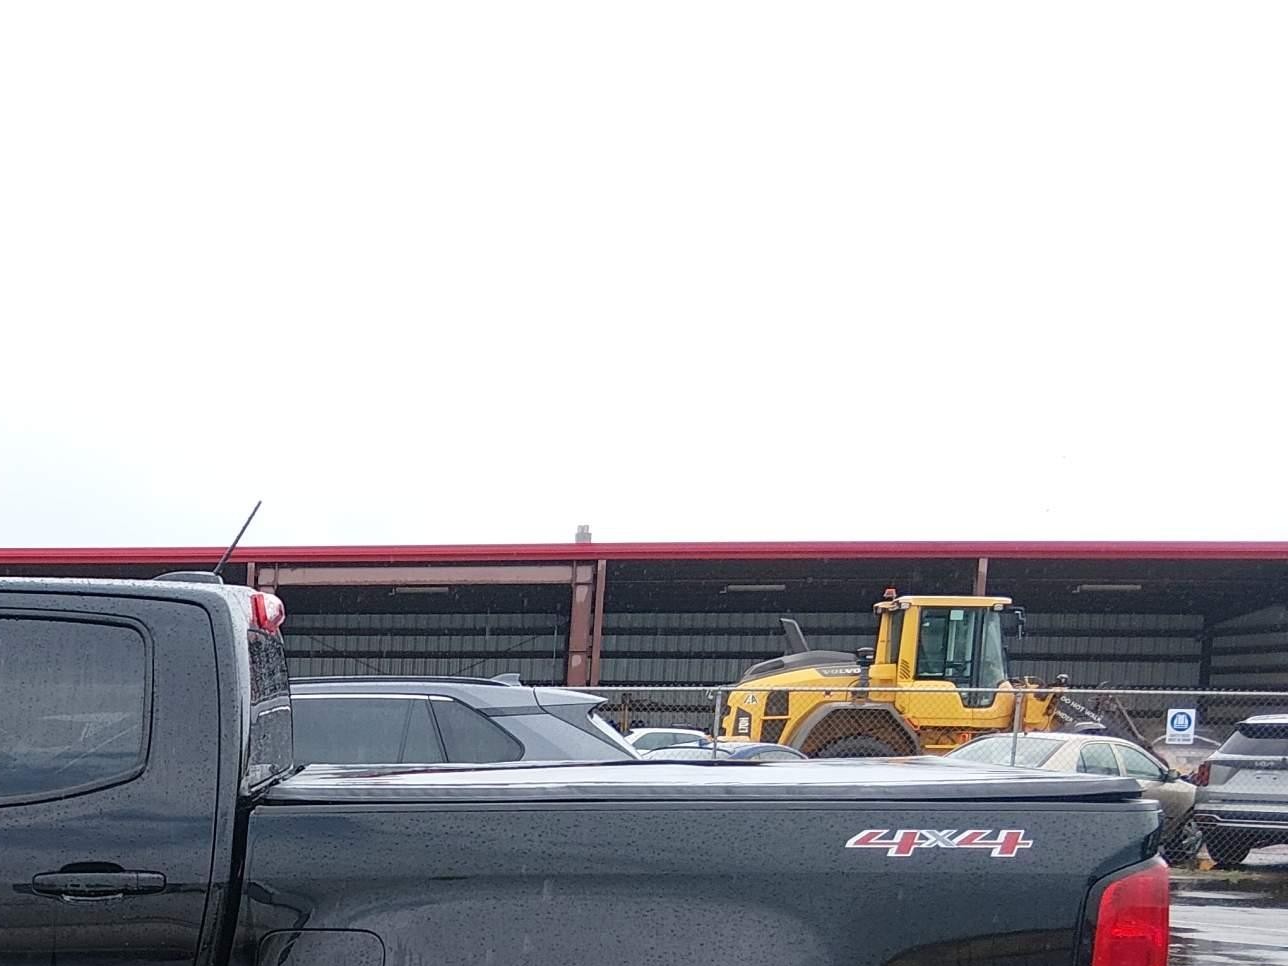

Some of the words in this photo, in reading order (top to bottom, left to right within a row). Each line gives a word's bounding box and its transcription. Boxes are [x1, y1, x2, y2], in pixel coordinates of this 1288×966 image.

[1060, 695, 1071, 704] DO
[1070, 701, 1085, 712] NOT
[1084, 708, 1102, 723] WALK
